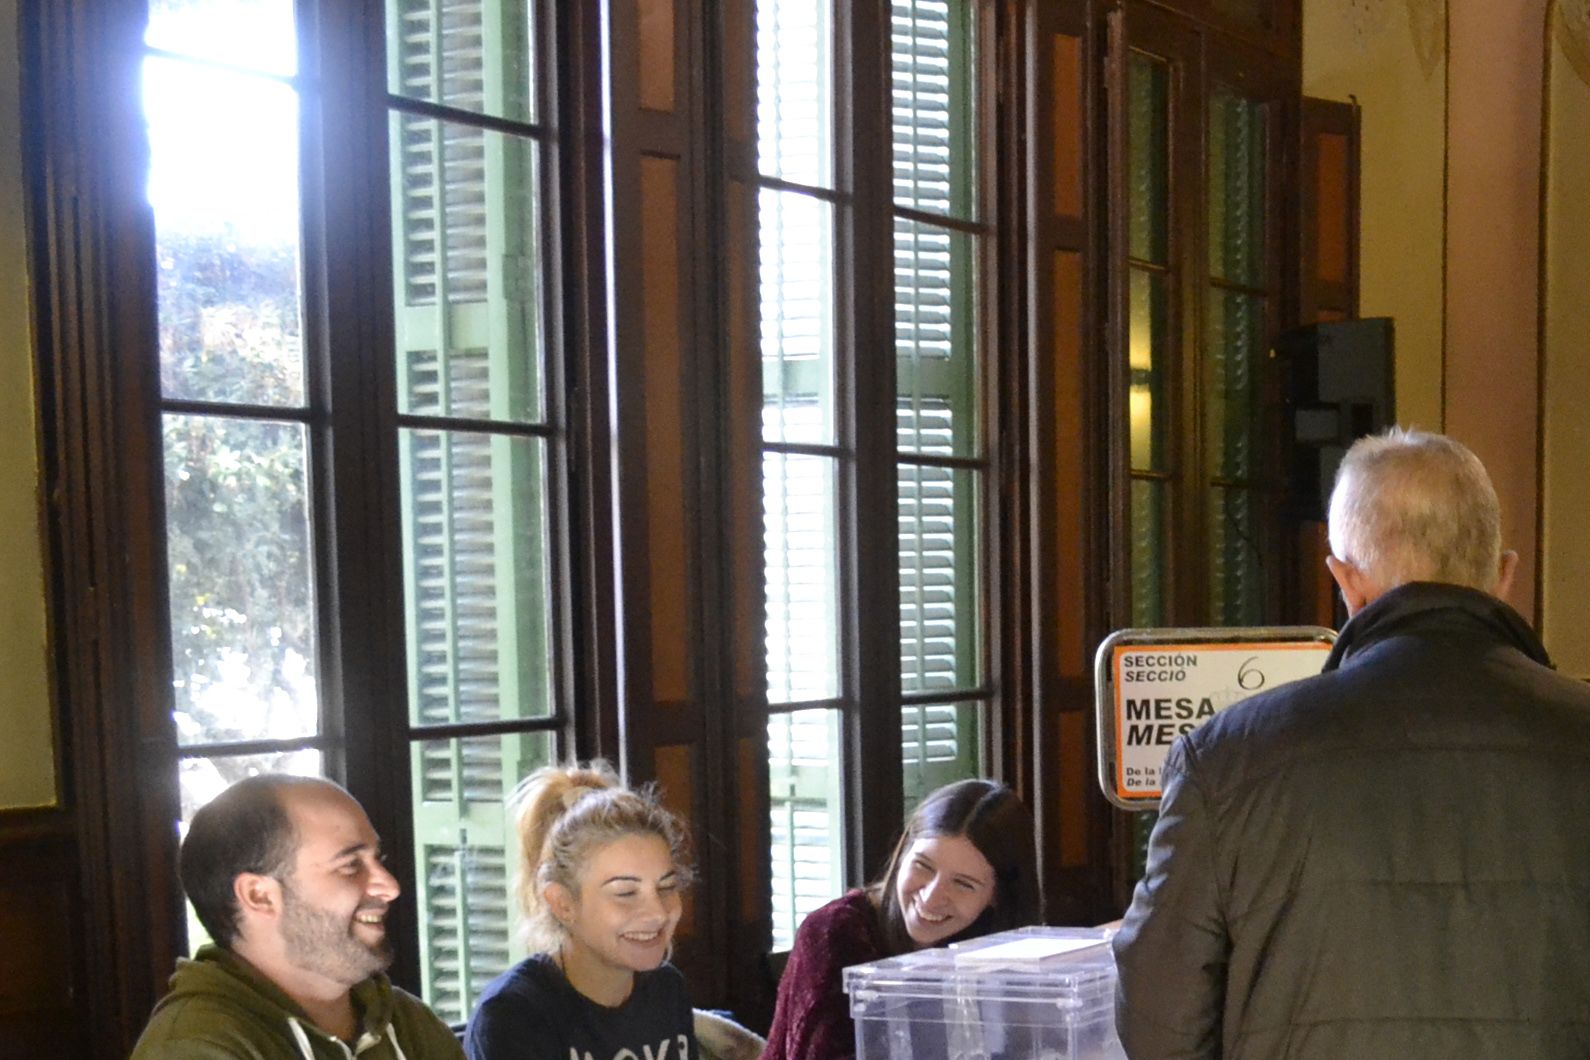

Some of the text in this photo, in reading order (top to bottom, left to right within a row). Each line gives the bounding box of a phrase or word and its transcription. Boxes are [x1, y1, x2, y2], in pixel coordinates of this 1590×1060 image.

[1124, 653, 1198, 668] SECCIÓN
[1237, 656, 1266, 690] 6
[1126, 697, 1216, 721] MESA
[1127, 722, 1197, 746] MES
